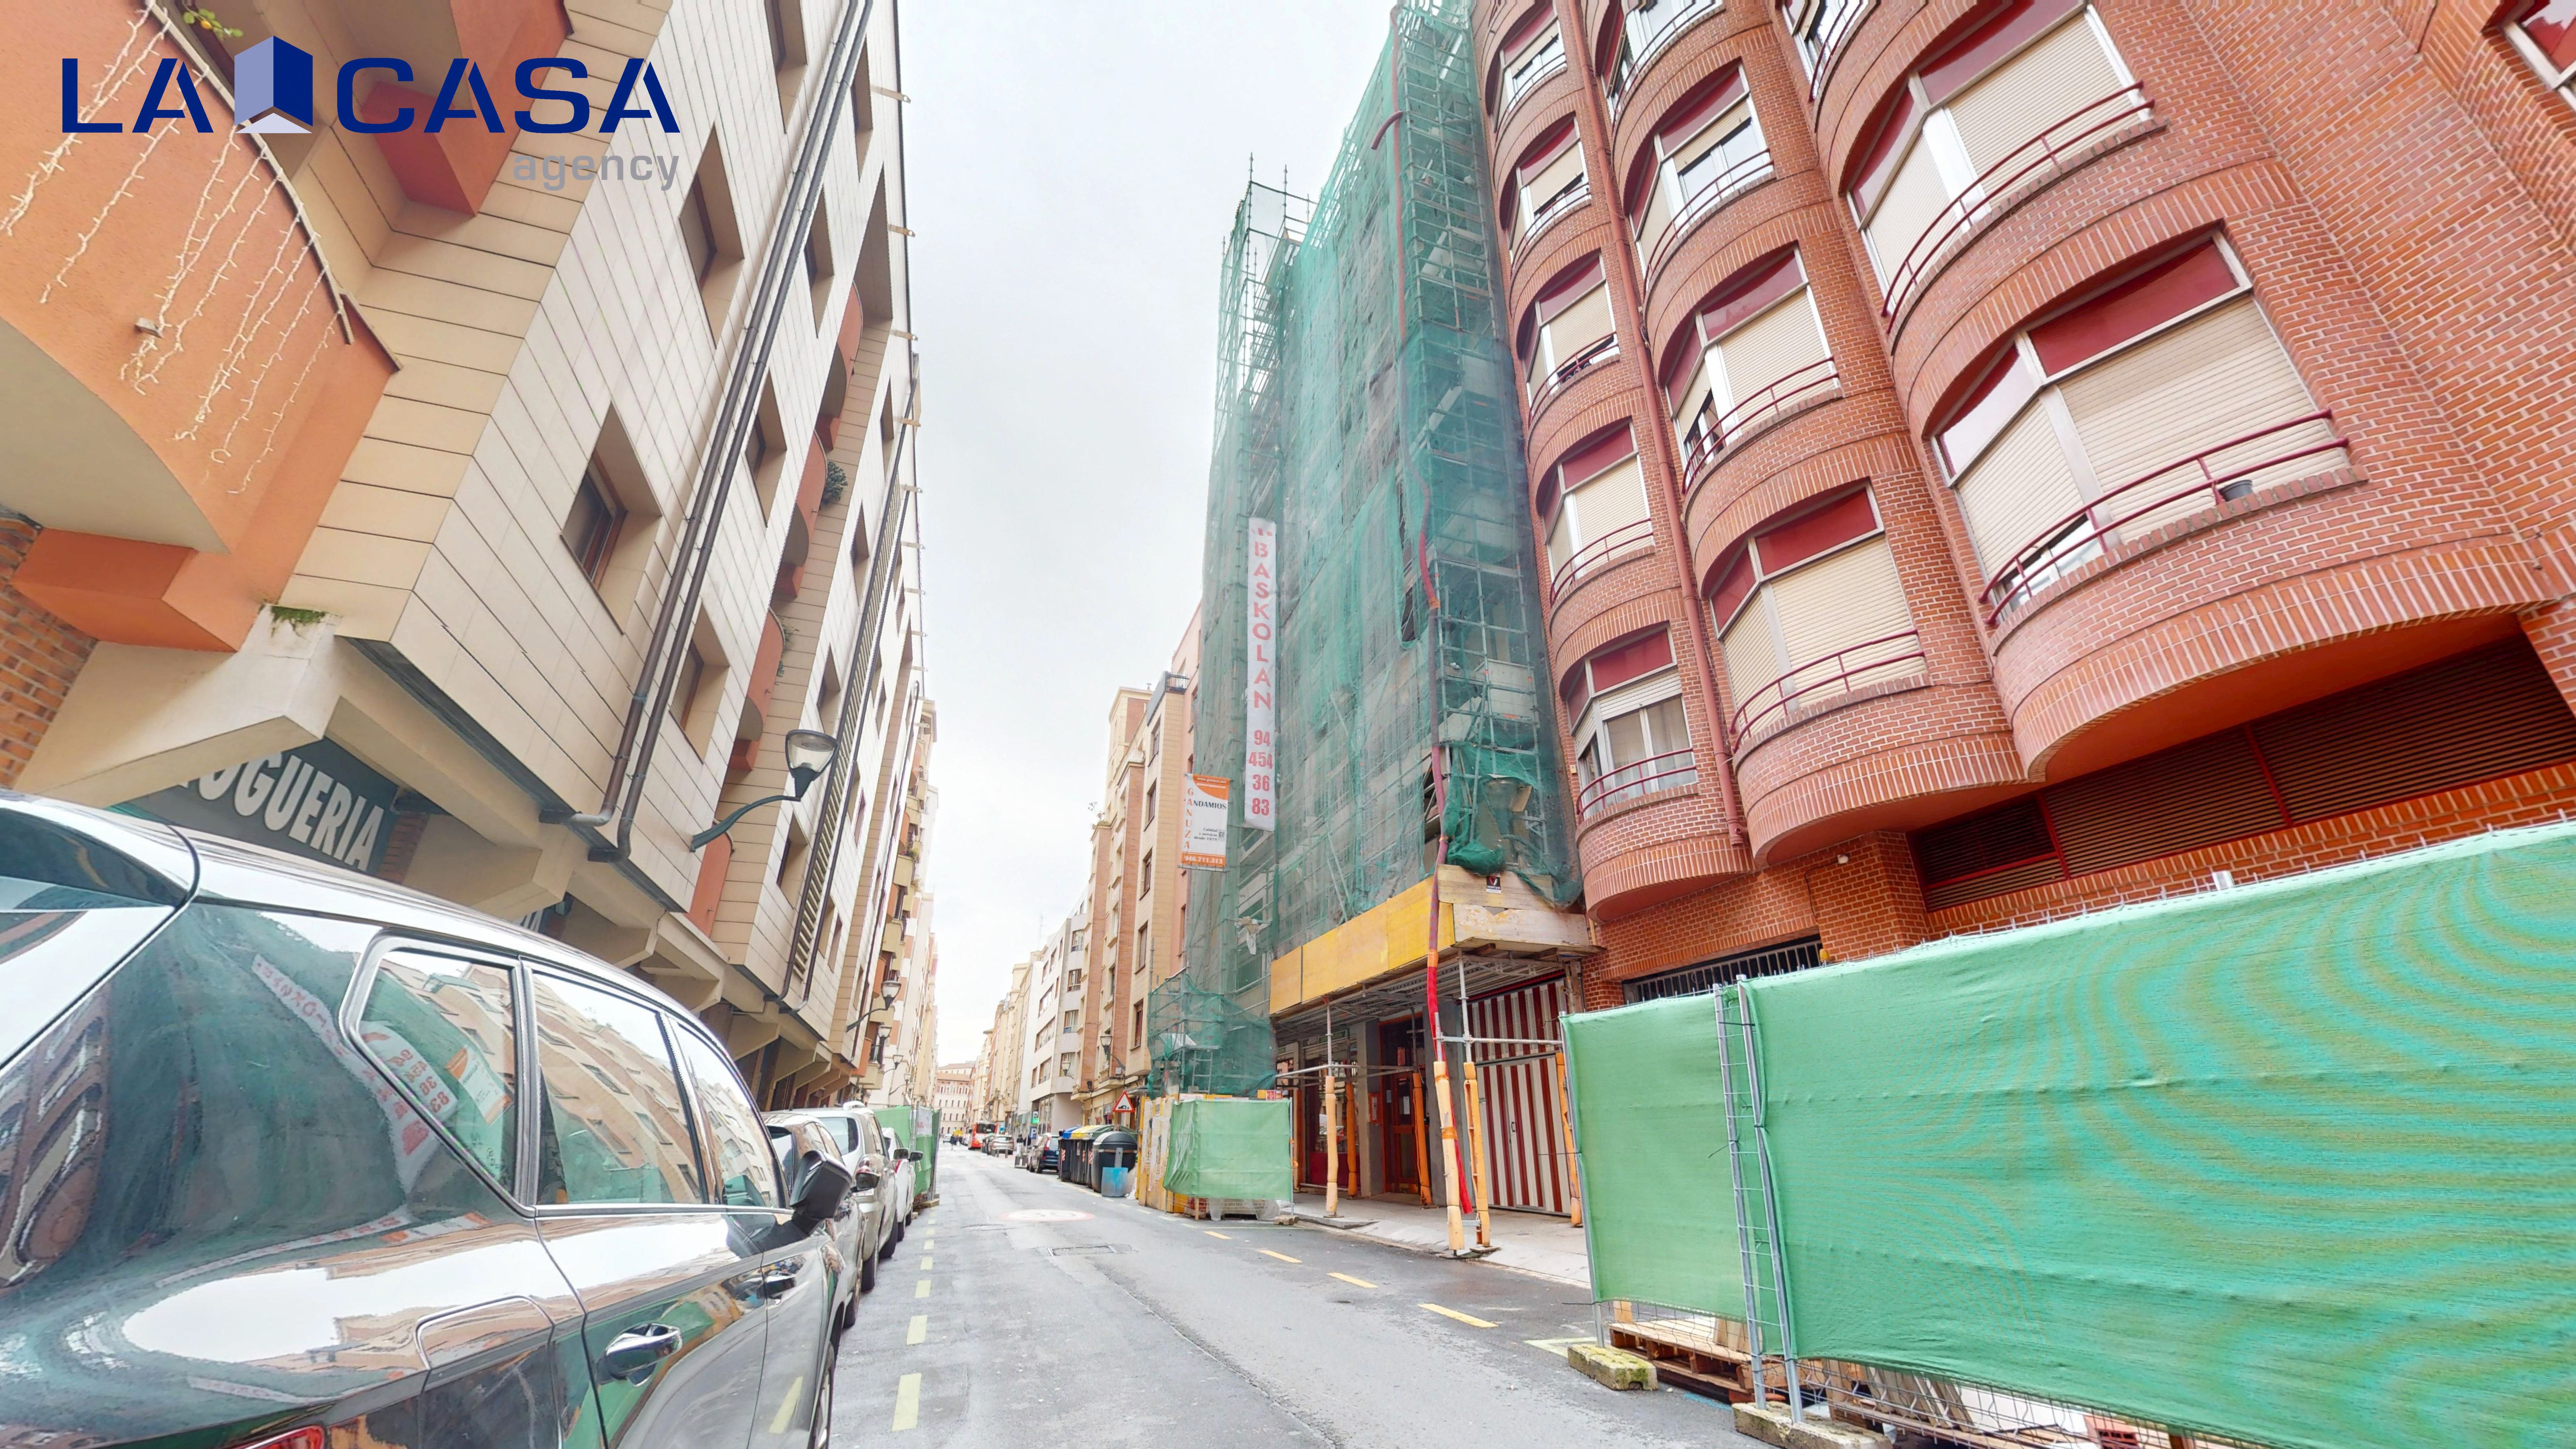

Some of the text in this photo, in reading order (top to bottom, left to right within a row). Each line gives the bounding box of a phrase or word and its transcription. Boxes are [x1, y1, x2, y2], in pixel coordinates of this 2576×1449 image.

[1253, 541, 1271, 709] BASKOLAN
[1254, 730, 1270, 746] 94
[1249, 752, 1273, 769] 454
[1252, 774, 1270, 792] 36
[171, 751, 384, 872] OGUERIA
[1251, 798, 1269, 816] 83
[1184, 788, 1194, 849] GANUZA
[1030, 1128, 1037, 1138] P
